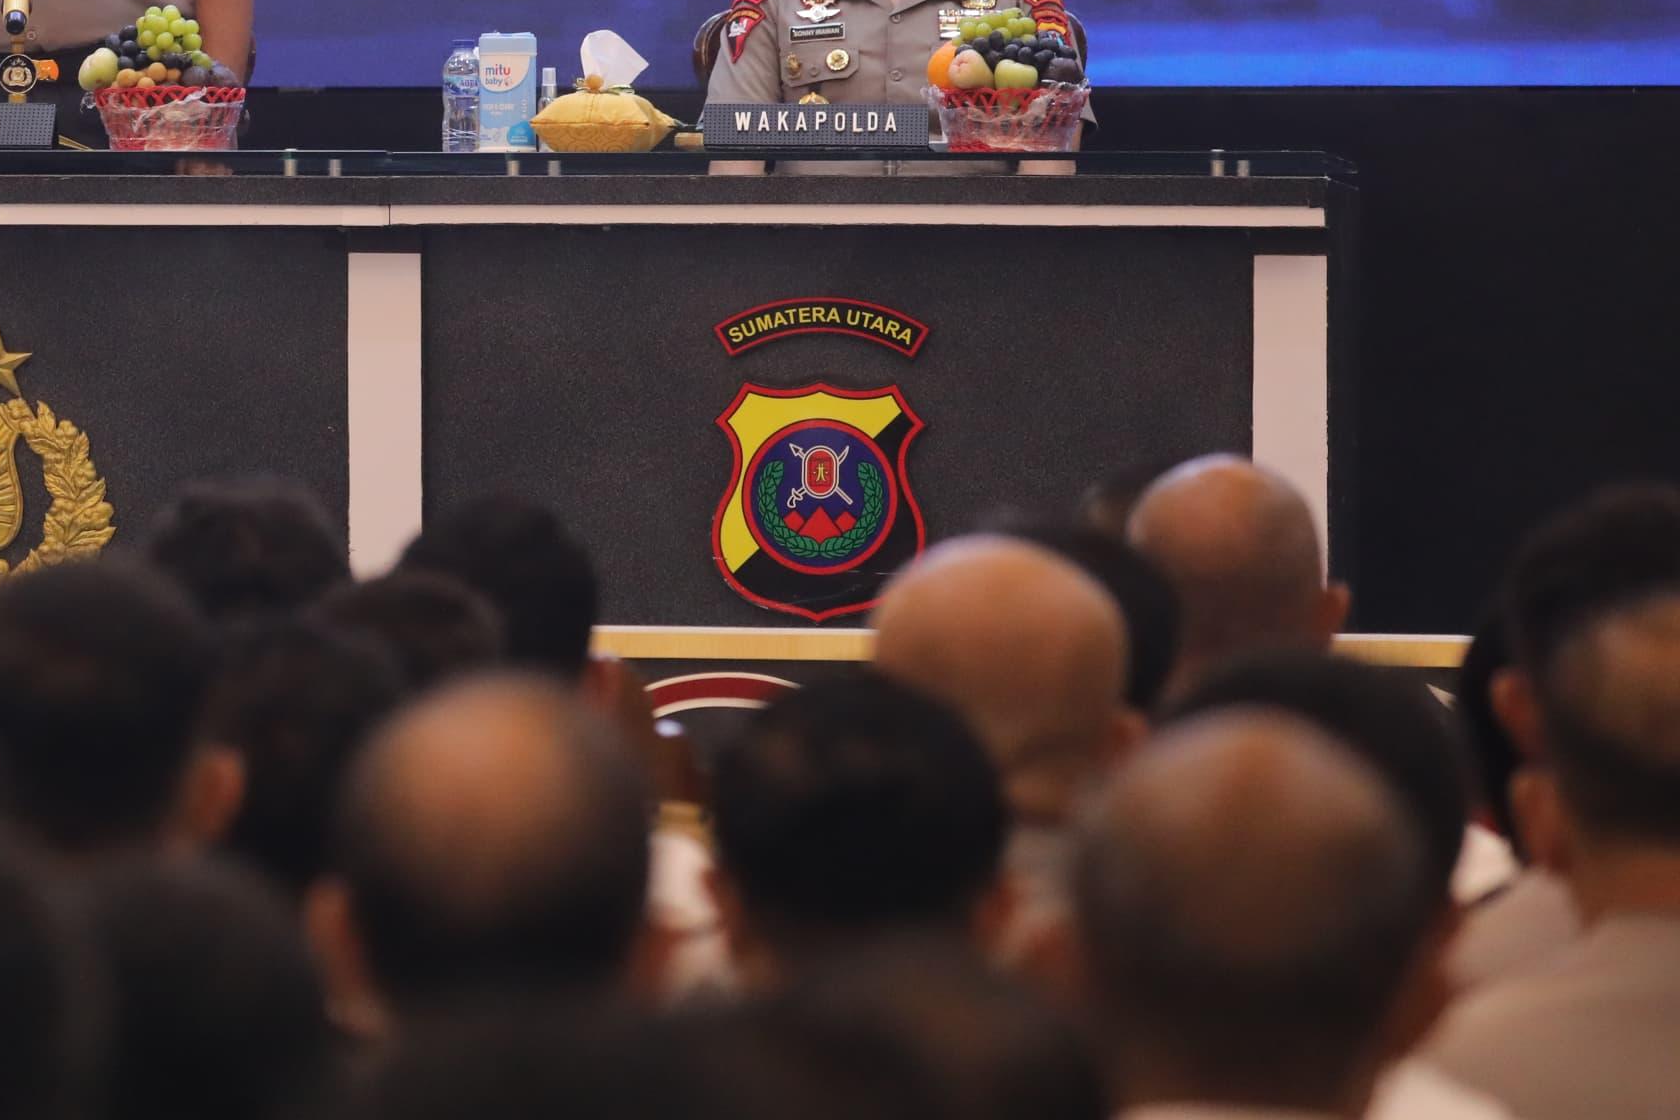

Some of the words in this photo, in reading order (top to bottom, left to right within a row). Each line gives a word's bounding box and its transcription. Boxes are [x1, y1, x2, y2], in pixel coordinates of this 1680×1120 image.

[485, 64, 511, 76] mitu
[735, 110, 898, 133] WAKAPOLDA
[728, 306, 841, 342] SUMATERA
[846, 309, 913, 345] UTARA
